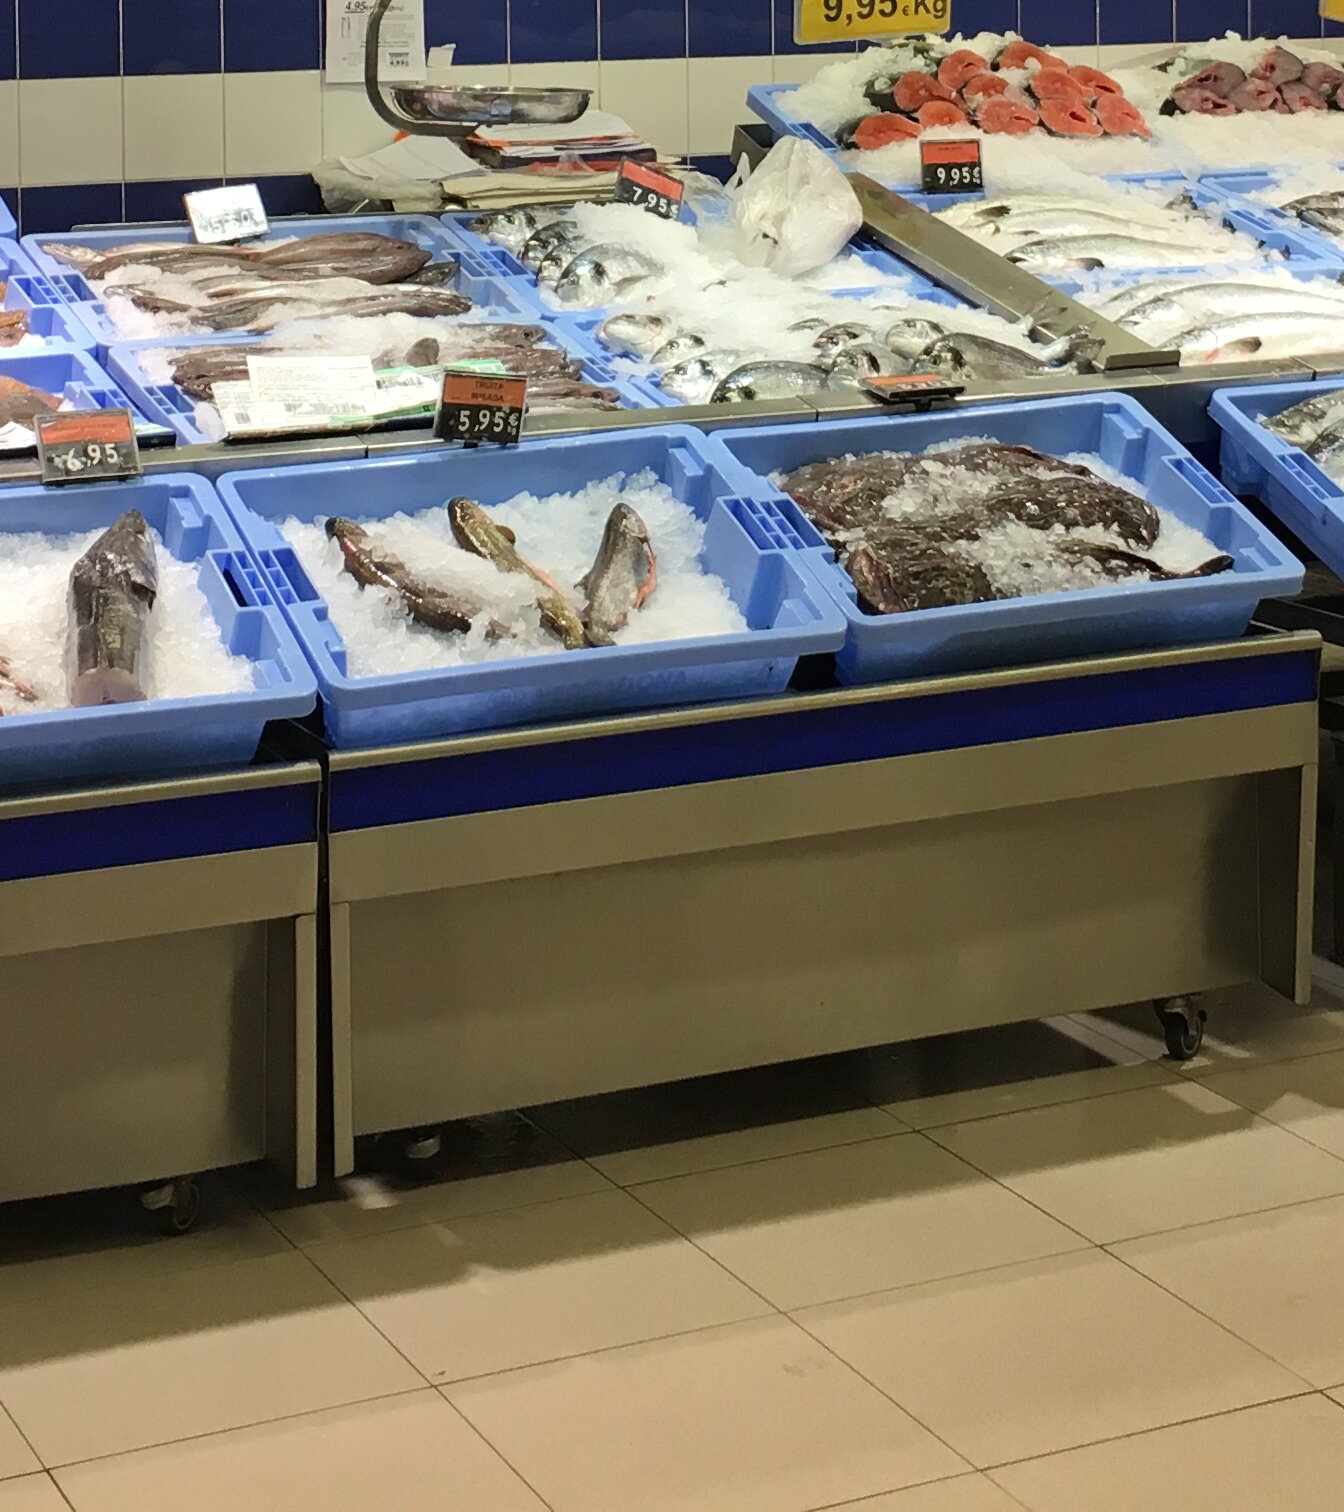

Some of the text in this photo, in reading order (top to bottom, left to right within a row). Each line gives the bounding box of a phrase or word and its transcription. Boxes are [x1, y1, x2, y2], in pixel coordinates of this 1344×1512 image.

[936, 167, 970, 186] 9,95
[633, 186, 668, 213] 7,95
[458, 409, 504, 433] 5,95
